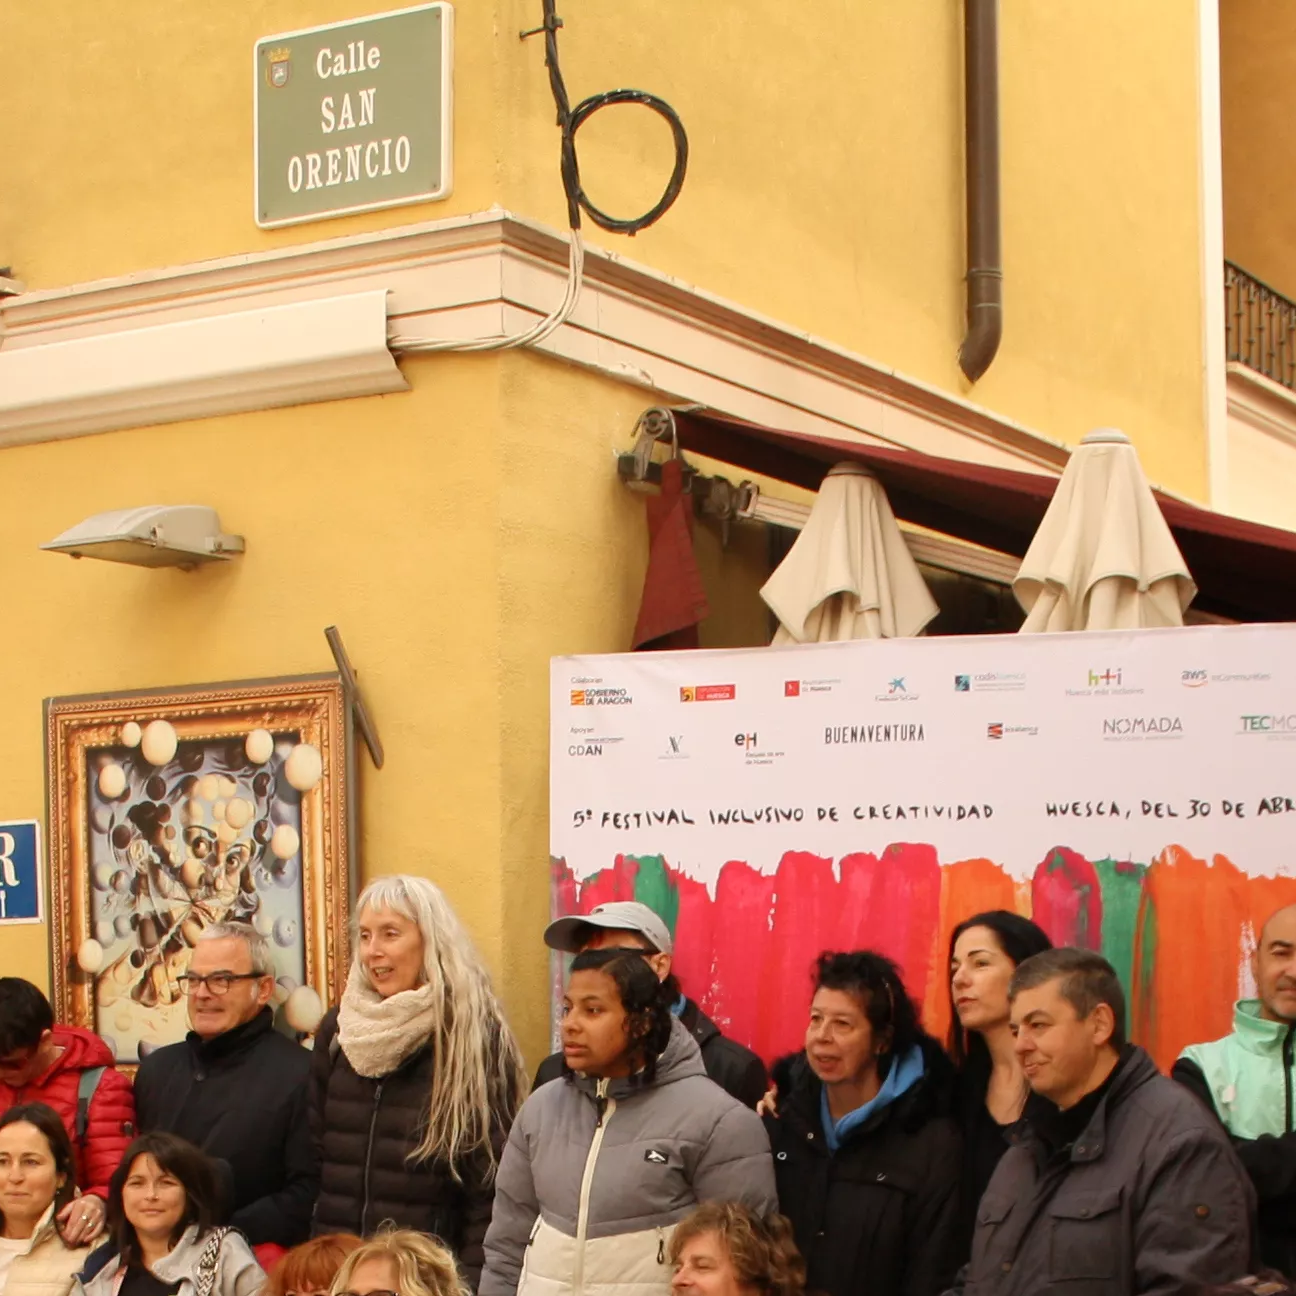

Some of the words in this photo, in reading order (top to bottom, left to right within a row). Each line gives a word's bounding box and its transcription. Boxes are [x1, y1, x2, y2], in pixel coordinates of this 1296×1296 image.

[316, 40, 381, 79] Calle
[321, 87, 376, 134] SAN
[287, 135, 411, 193] ORENCIO
[1182, 669, 1207, 680] aws
[585, 688, 627, 697] GOBIERNO
[585, 698, 595, 706] DE
[825, 723, 925, 744] BUENAVENTURA
[1103, 717, 1183, 734] NOMADA
[568, 745, 602, 756] CDAN
[601, 807, 695, 830] FESTIVAL
[709, 805, 804, 825] INCLUSIVO
[818, 806, 839, 822] DE
[853, 804, 994, 822] CREATIVIDAD
[1046, 800, 1131, 820] HUESCA,
[1141, 800, 1178, 818] DEL
[1187, 799, 1211, 819] 30
[1222, 800, 1245, 818] DE
